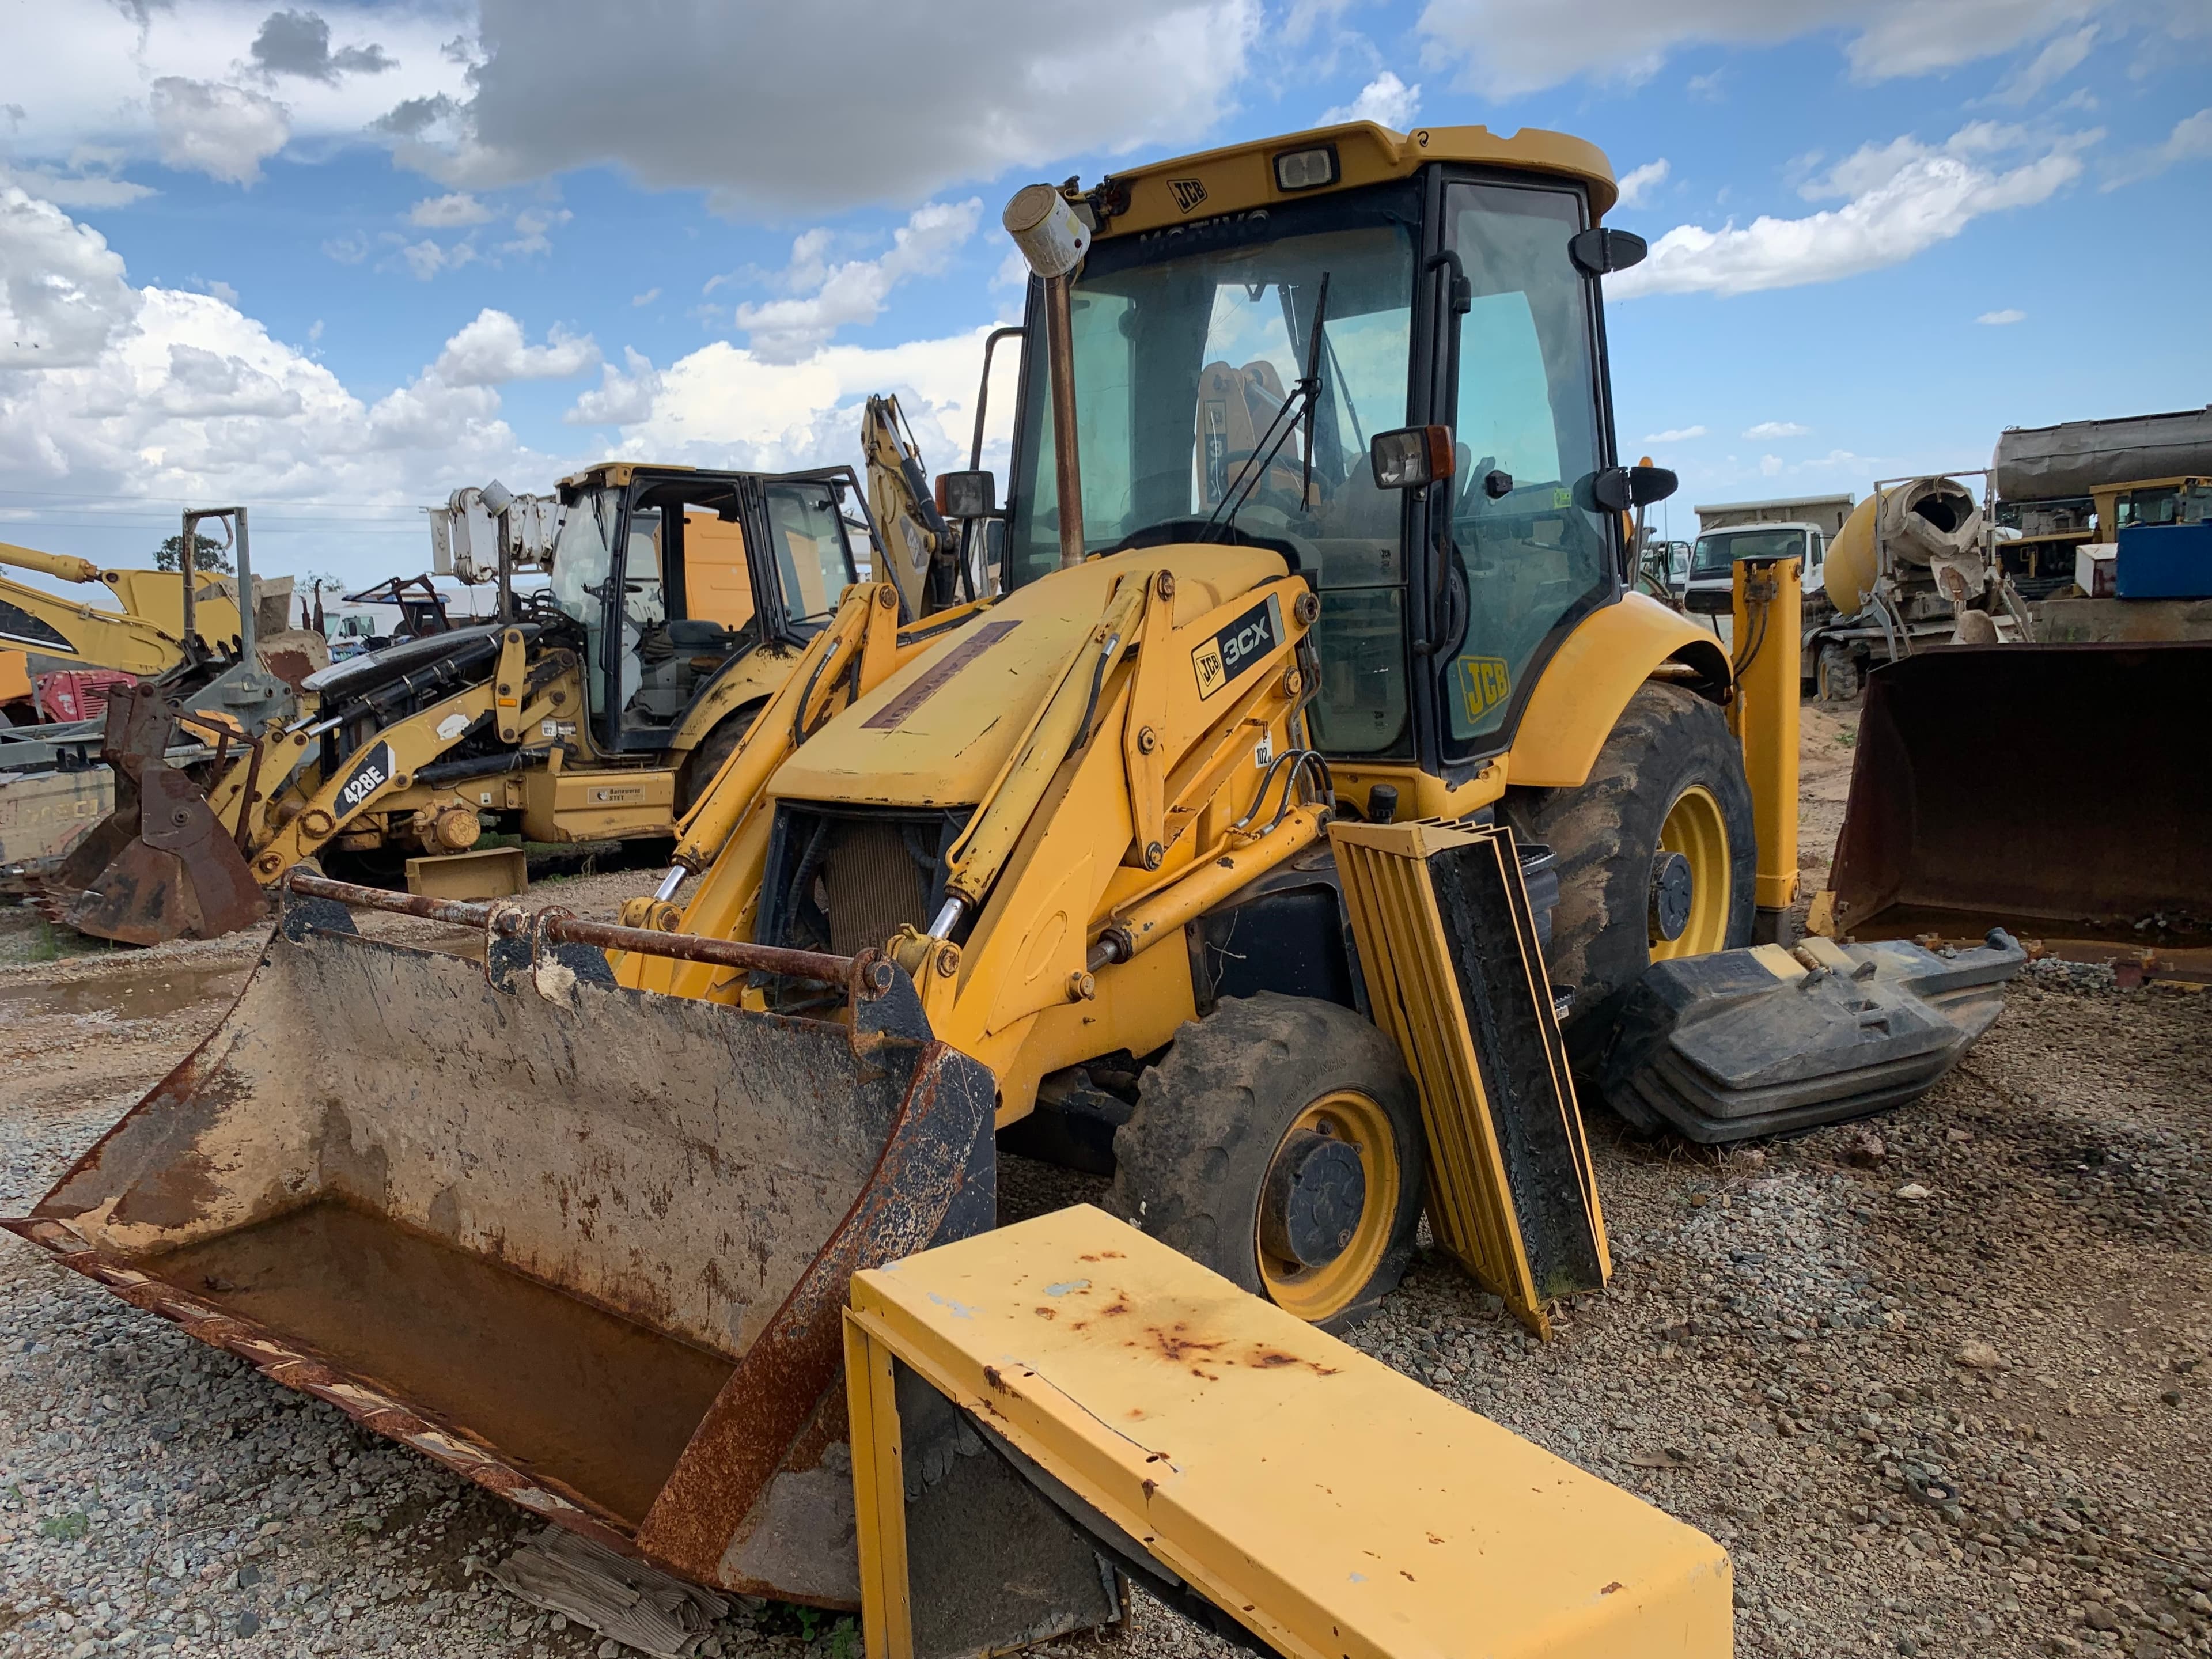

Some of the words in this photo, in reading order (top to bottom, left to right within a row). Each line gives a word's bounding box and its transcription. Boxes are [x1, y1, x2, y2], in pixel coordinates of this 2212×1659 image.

[1174, 181, 1205, 209] JCB
[1200, 654, 1220, 683] JCB
[1223, 615, 1270, 666] 3CX
[1467, 662, 1508, 715] JCB
[1256, 747, 1268, 765] 102
[343, 765, 385, 804] 428E
